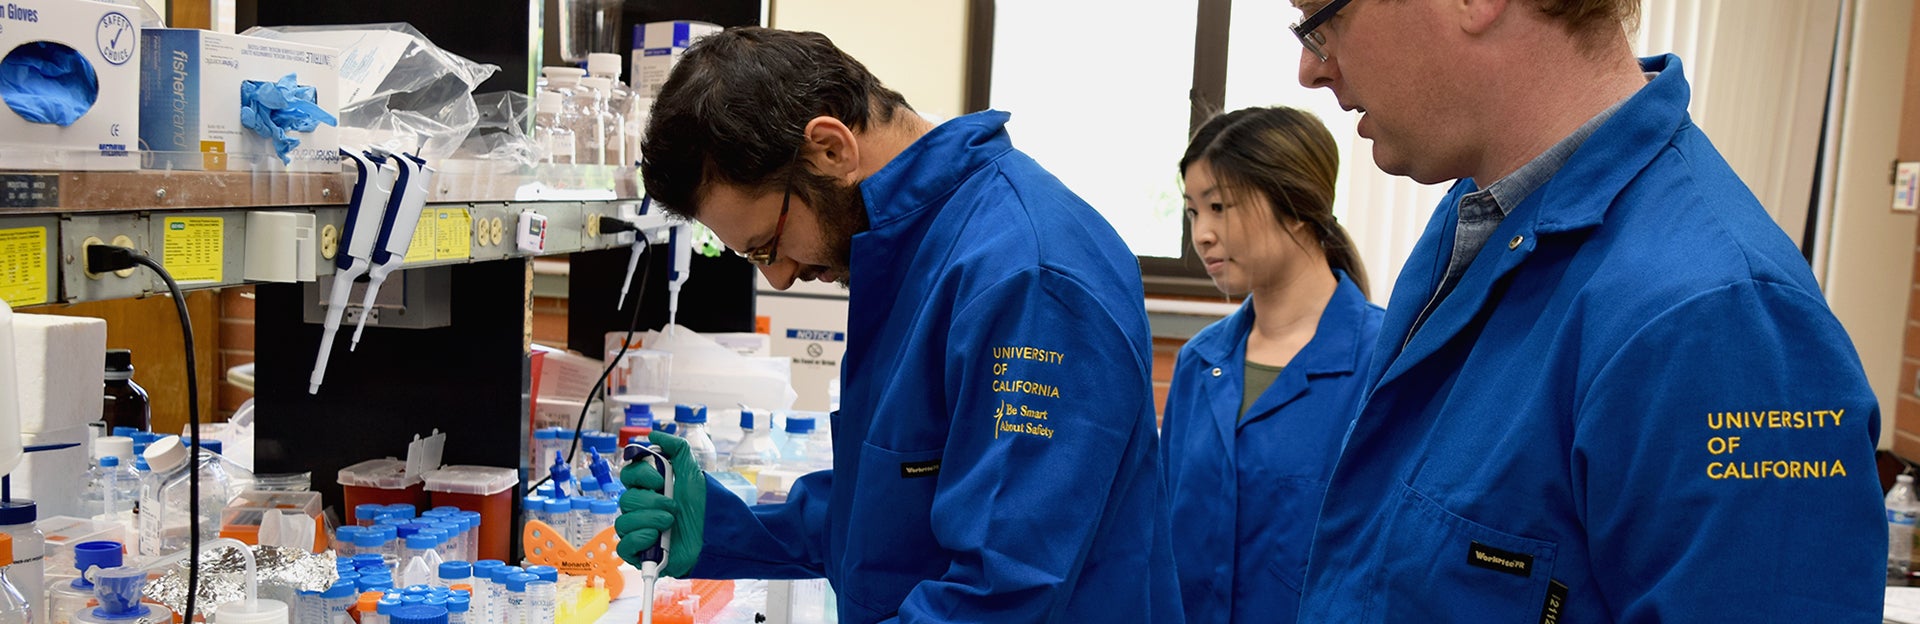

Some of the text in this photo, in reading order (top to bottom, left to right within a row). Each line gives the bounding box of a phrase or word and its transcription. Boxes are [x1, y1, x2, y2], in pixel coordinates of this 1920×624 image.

[7, 3, 38, 23] Gloves
[103, 16, 129, 31] SAFETY
[104, 46, 129, 61] CHOICE
[173, 50, 189, 148] fisherbrand
[797, 328, 834, 341] NOTICE
[993, 347, 1065, 365] UNIVERSITY
[993, 363, 1008, 376] OF
[992, 380, 1060, 398] CALIFORNIA
[1006, 404, 1048, 420] Be Smart
[1707, 409, 1845, 430] UNIVERSITY
[1000, 421, 1054, 439] About Safety
[1707, 436, 1741, 455] OF
[1706, 459, 1847, 480] CALIFORNIA
